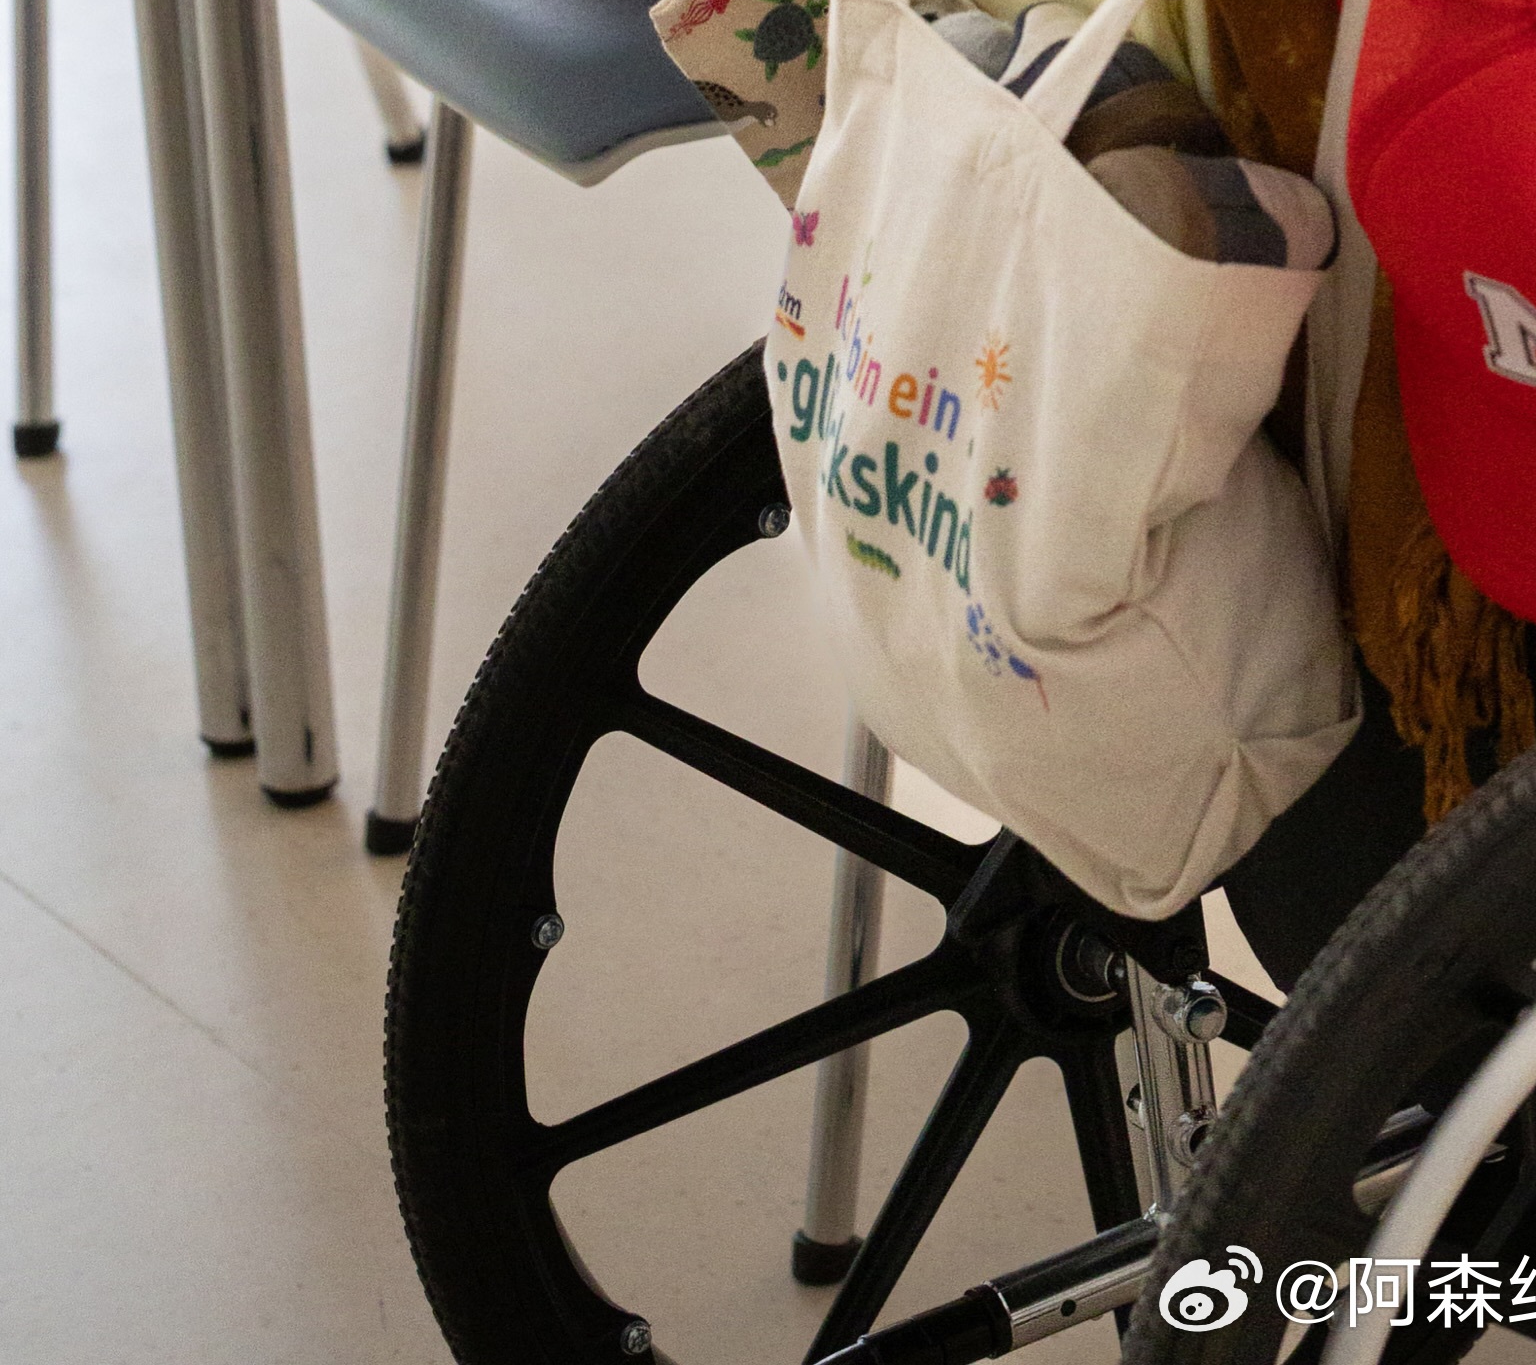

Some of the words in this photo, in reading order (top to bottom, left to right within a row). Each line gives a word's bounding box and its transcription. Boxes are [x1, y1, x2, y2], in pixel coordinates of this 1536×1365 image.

[777, 279, 801, 321] dm
[846, 317, 881, 406] bin
[889, 366, 960, 442] ein
